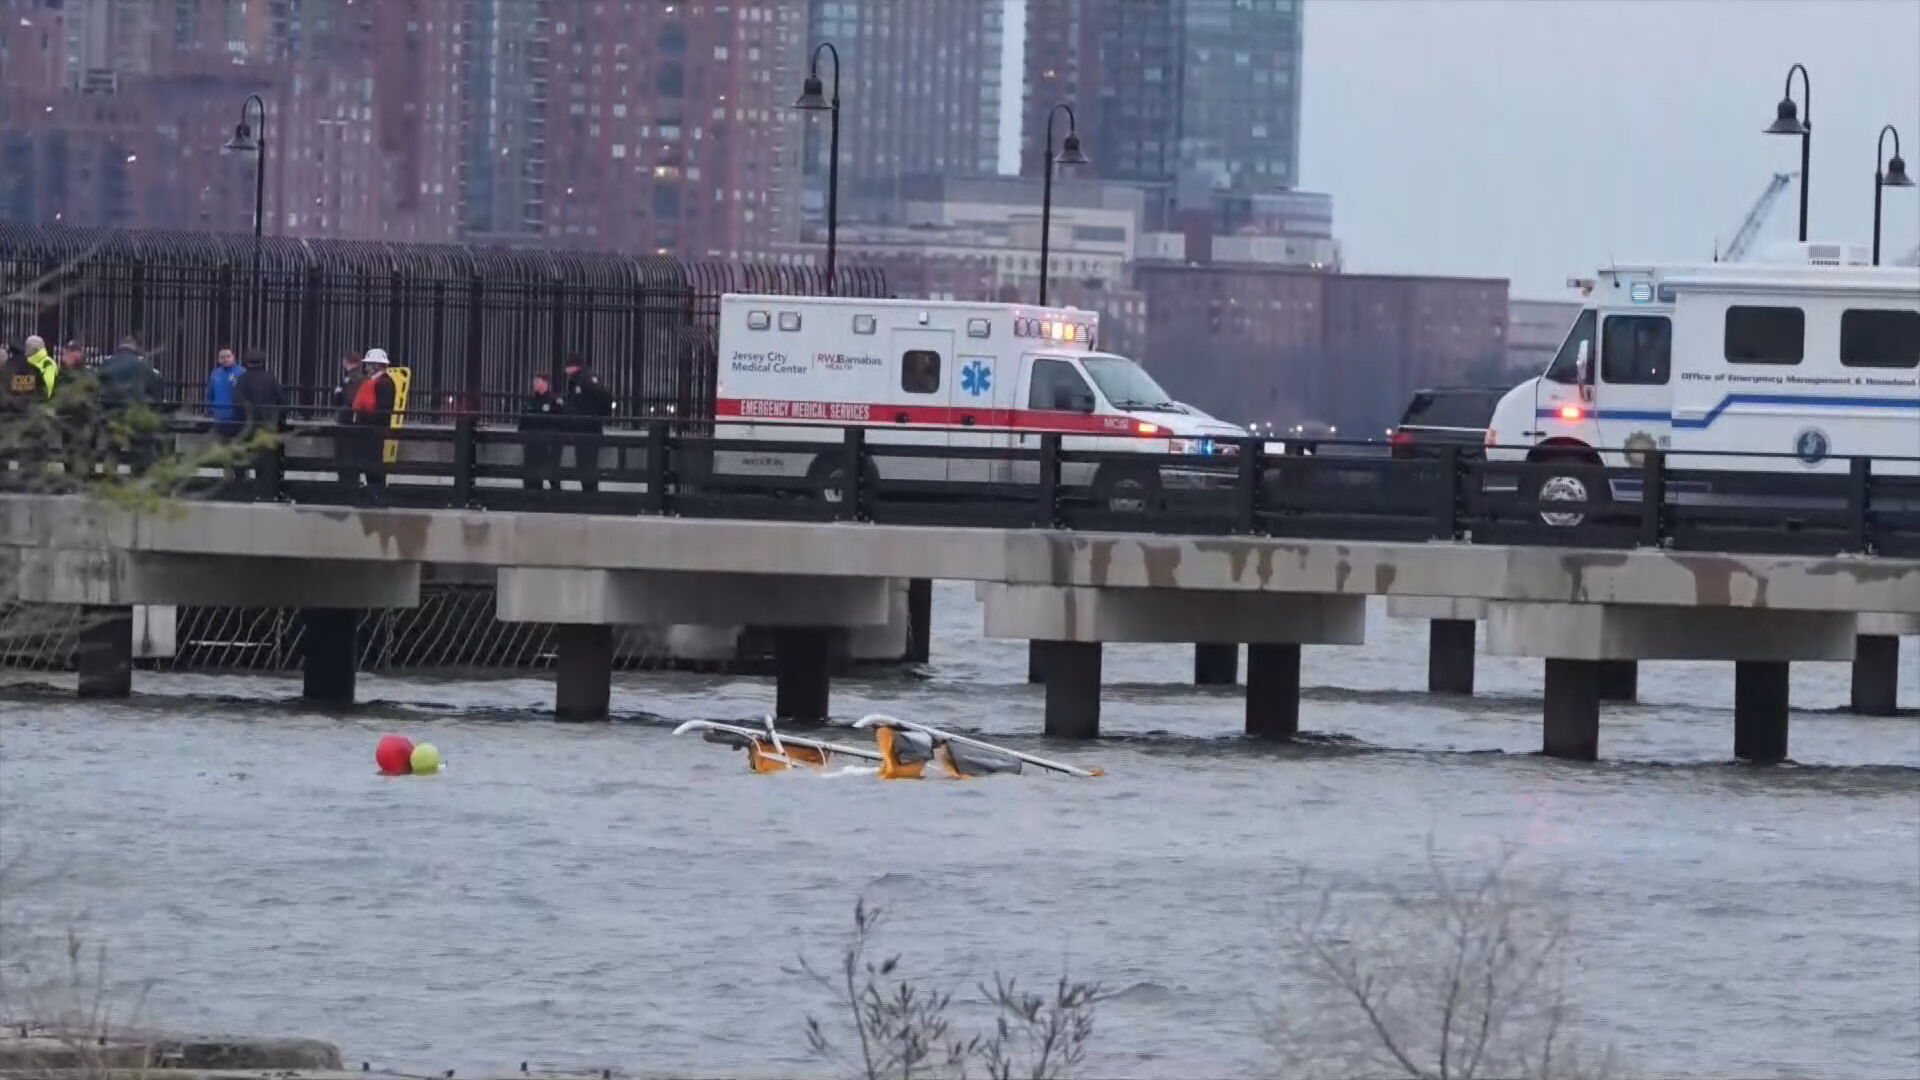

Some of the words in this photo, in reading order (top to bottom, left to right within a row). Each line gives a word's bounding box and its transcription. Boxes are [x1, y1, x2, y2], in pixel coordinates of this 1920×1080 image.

[732, 352, 764, 363] Jersey
[767, 352, 788, 363] City
[818, 353, 882, 365] RWJBarnabas
[732, 362, 770, 373] Medical
[773, 363, 808, 374] Center
[1681, 372, 1712, 381] Office
[1728, 374, 1783, 384] Emergency
[1786, 375, 1850, 385] Management
[740, 400, 788, 417] EMERGENCY
[791, 402, 827, 419] MEDICAL
[829, 404, 870, 420] SERVICES
